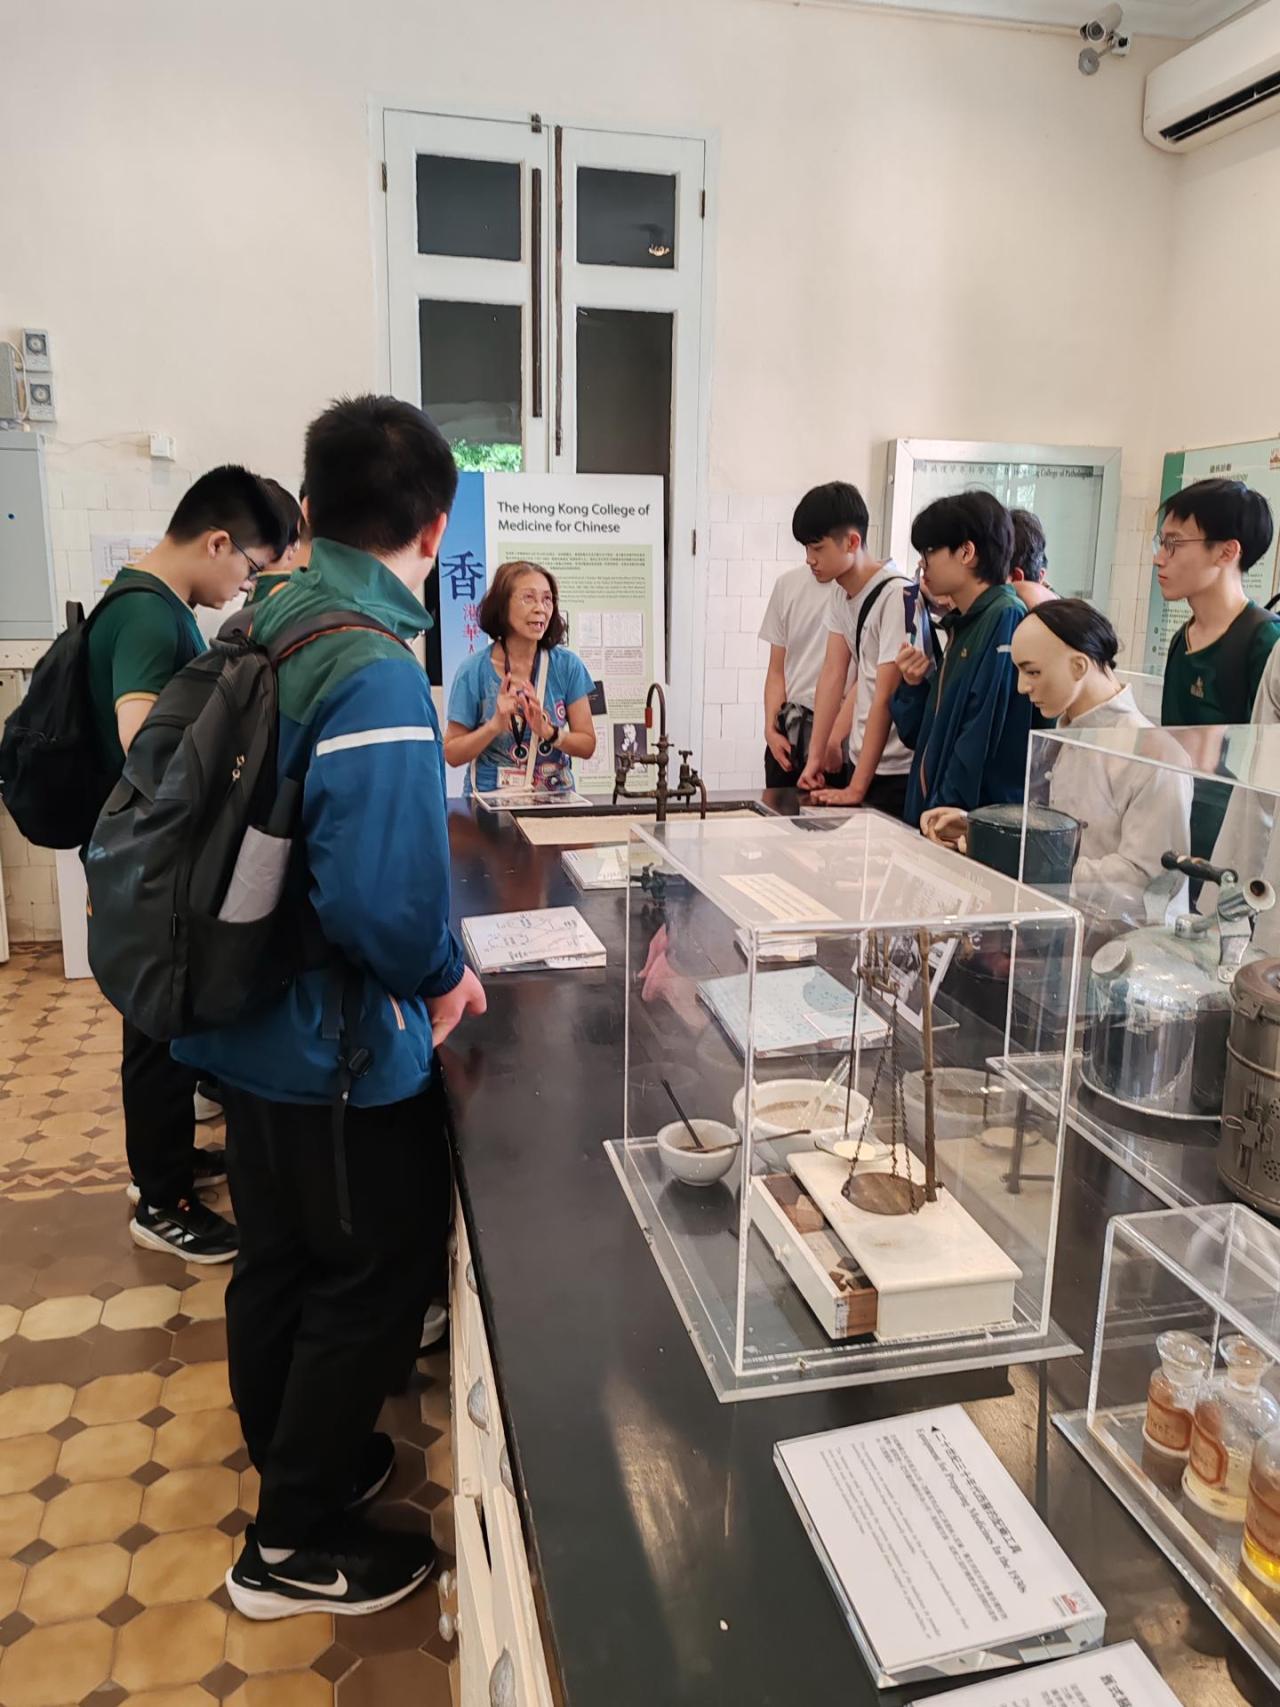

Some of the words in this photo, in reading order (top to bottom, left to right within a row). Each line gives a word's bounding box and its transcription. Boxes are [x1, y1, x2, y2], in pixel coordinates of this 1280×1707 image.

[497, 501, 520, 513] The
[522, 502, 555, 517] Hong
[558, 502, 589, 517] Kong
[591, 503, 635, 518] College
[638, 503, 650, 516] of
[498, 519, 552, 532] Medicine
[555, 520, 571, 532] for
[574, 520, 621, 533] Chinese
[441, 549, 484, 601] 香
[944, 1471, 971, 1507] Preparing
[998, 1555, 1010, 1569] the
